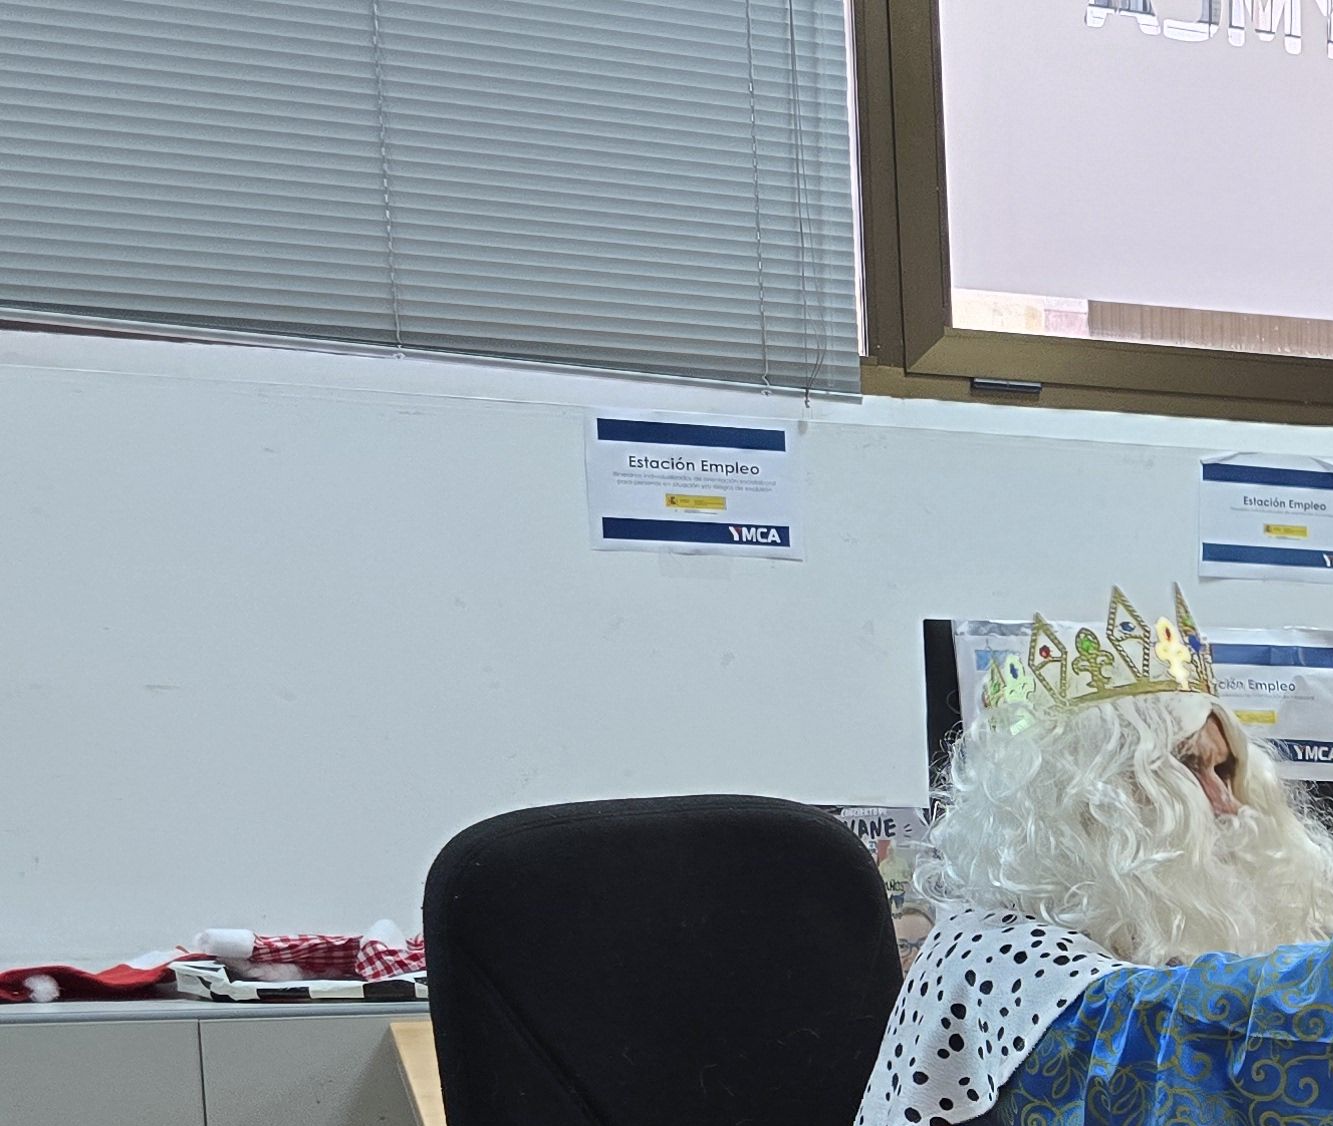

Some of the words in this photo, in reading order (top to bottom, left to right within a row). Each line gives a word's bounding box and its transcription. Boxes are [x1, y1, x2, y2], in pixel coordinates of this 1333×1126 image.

[629, 455, 695, 472] Estación
[701, 459, 760, 476] Empleo
[1243, 495, 1286, 510] Estación
[1289, 499, 1327, 514] Empleo
[729, 526, 781, 543] YMCA
[1215, 677, 1245, 690] ción
[1248, 679, 1296, 694] Empleo
